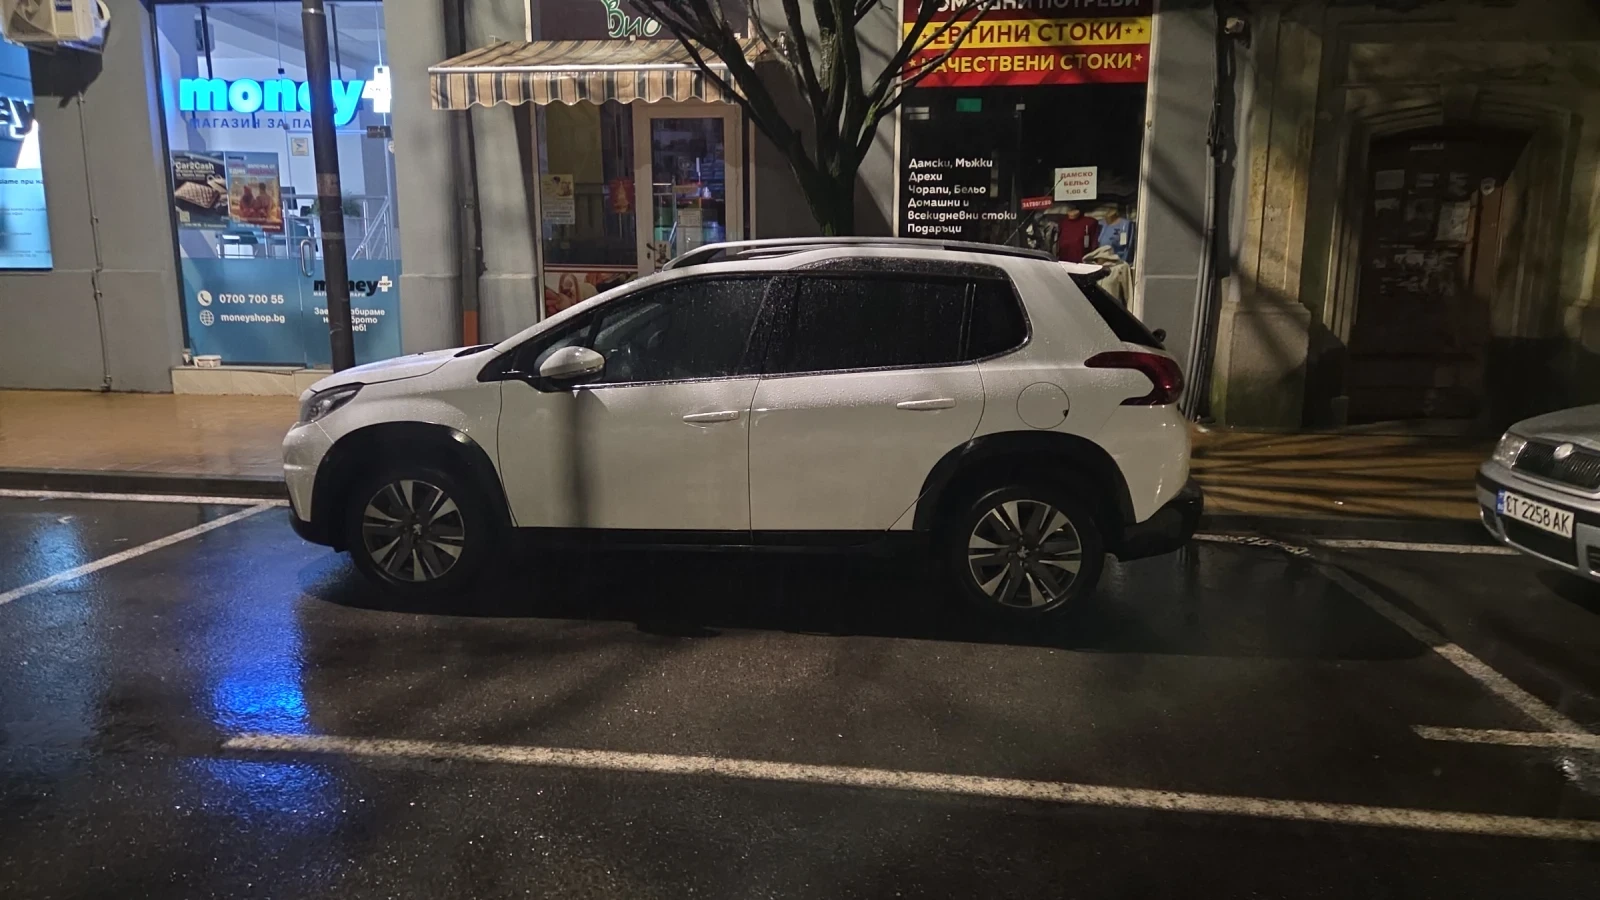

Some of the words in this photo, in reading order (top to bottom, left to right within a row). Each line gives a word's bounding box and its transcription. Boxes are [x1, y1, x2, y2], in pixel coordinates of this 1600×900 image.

[1037, 22, 1122, 41] СТОКИ
[921, 54, 1055, 73] АЧЕСТВЕНИ
[1060, 53, 1133, 70] СТОКИ
[268, 118, 287, 129] ЗА
[908, 158, 953, 169] Дамски,
[955, 157, 993, 168] Мъжки
[908, 171, 943, 183] Дрехи
[908, 184, 951, 196] Чорапи,
[954, 184, 986, 194] Бельо
[907, 197, 960, 208] Домашни
[963, 199, 969, 207] и
[981, 210, 1017, 220] стоки
[907, 223, 962, 235] Подаръци
[219, 293, 246, 304] 0700
[249, 294, 268, 304] 700
[270, 294, 285, 304] 55
[220, 312, 286, 324] moneyshop.bg
[1521, 501, 1550, 526] 2258
